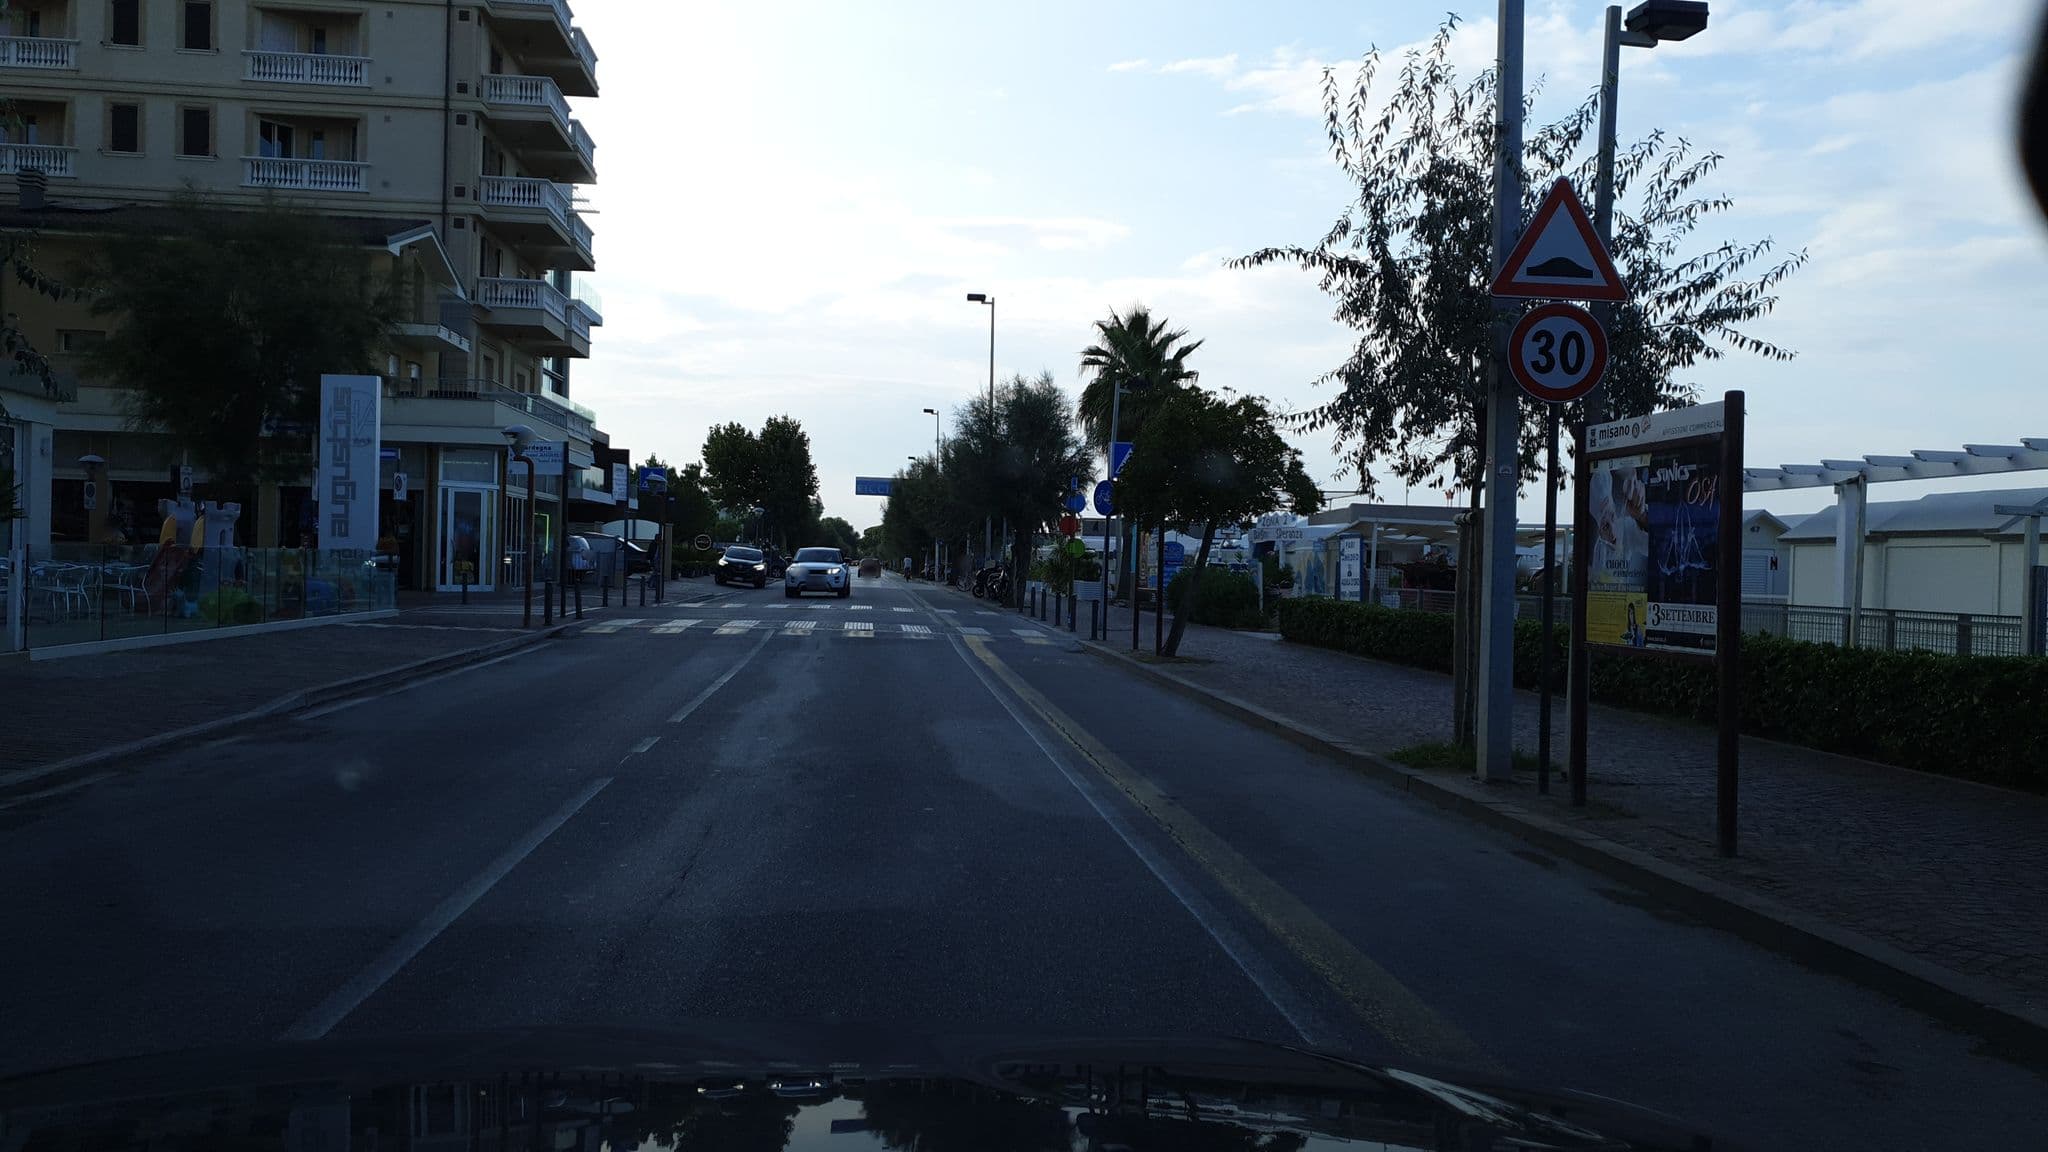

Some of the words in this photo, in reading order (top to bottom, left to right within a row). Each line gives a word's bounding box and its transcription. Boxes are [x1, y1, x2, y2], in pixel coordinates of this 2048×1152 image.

[1530, 329, 1586, 376] 30
[1599, 423, 1630, 441] misano
[1651, 603, 1661, 626] 3
[1660, 608, 1715, 624] SETTEMBRE
